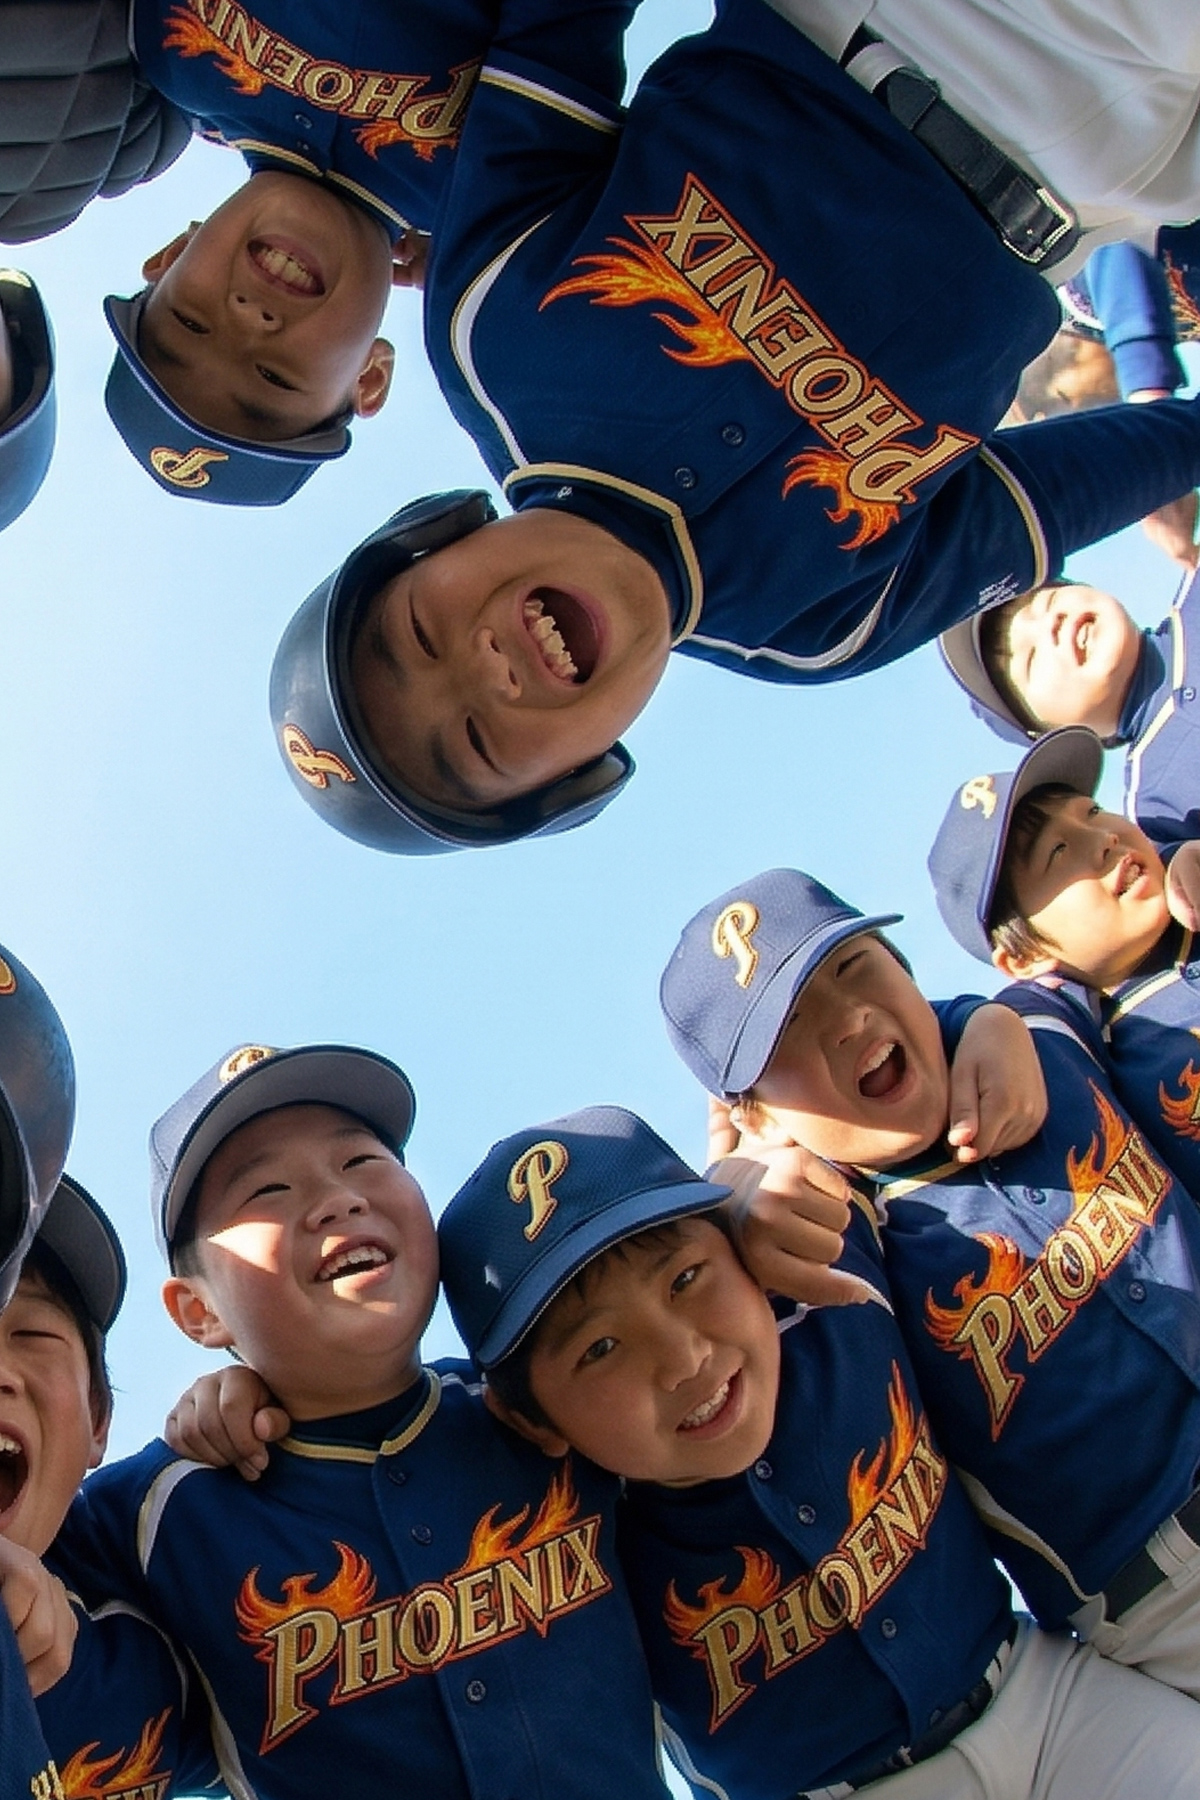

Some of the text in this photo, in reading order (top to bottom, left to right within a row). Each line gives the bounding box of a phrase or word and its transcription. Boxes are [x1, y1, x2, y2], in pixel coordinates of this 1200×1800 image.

[188, 0, 482, 140] PHOENI
[626, 174, 980, 502] PHOENIX
[147, 446, 230, 488] P
[282, 723, 356, 789] P
[712, 900, 760, 989] P
[507, 1140, 569, 1241] P
[690, 1415, 947, 1733] PHOENIX
[258, 1514, 613, 1755] PHOENIX
